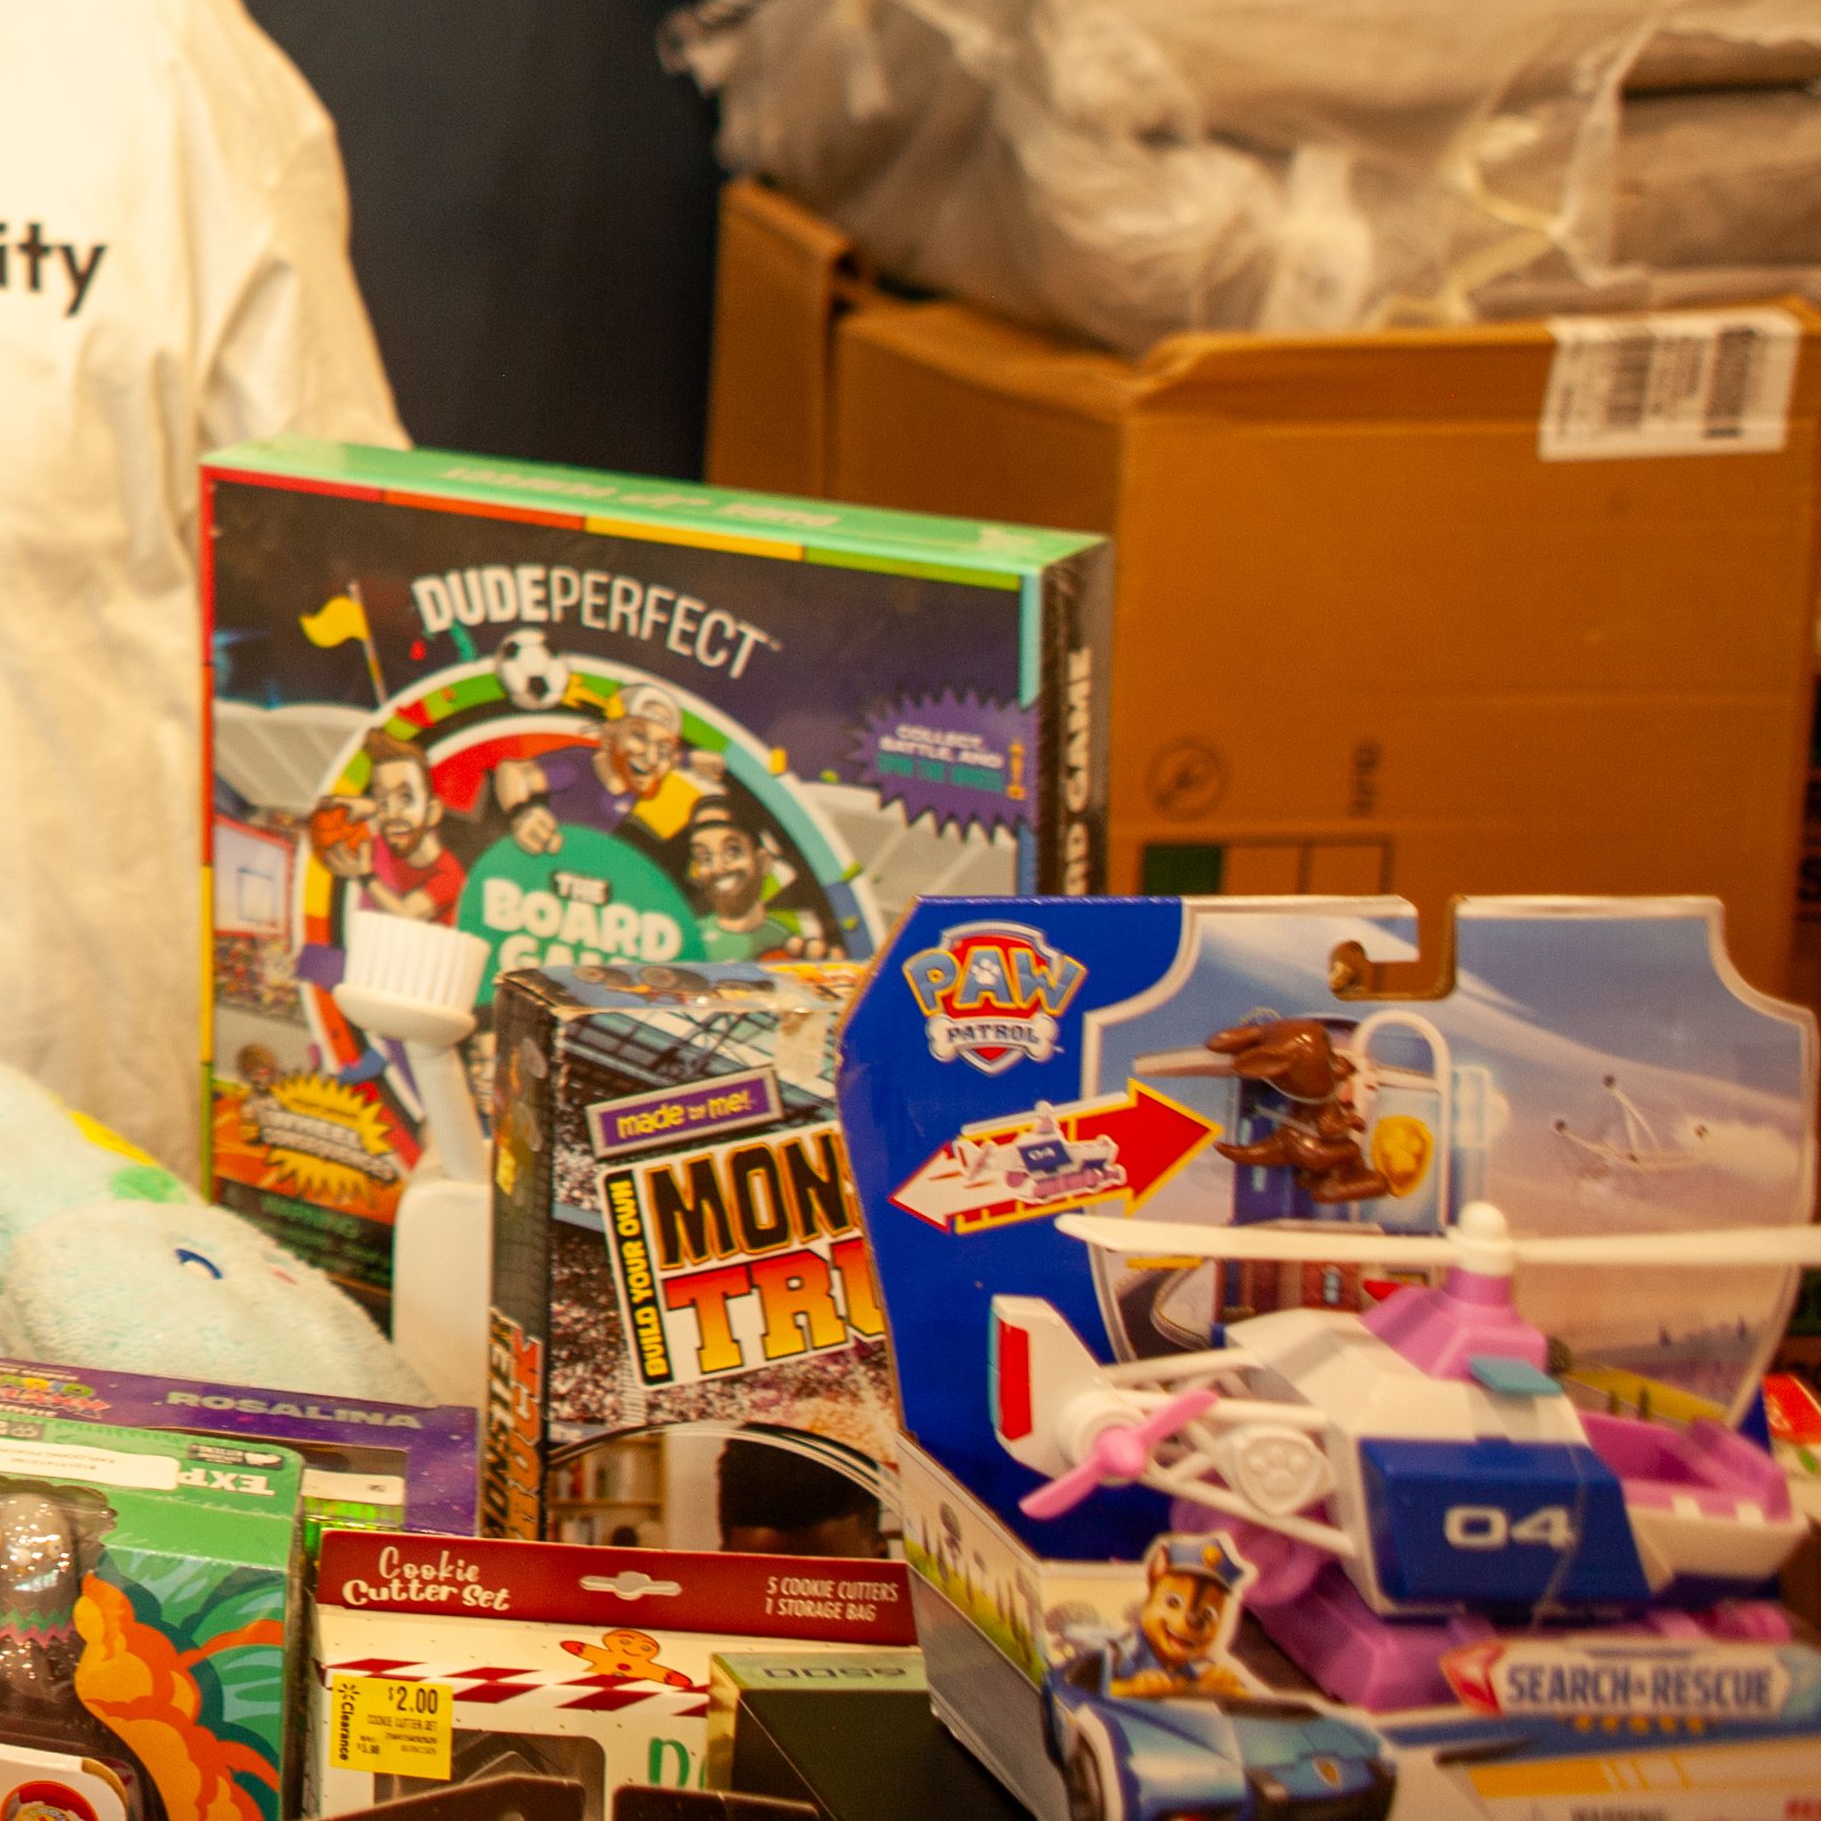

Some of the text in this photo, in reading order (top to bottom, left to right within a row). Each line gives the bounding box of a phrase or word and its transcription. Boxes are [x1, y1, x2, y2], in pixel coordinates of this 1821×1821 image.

[1067, 648, 1093, 815] GAME
[554, 871, 610, 905] THE
[483, 877, 682, 964] BOARD
[902, 945, 1089, 1016] PAW
[946, 1024, 1039, 1044] PATROL
[617, 1104, 685, 1139] made
[708, 1089, 751, 1118] me!
[1026, 1146, 1057, 1163] 04
[645, 1128, 858, 1271] MON
[609, 1180, 669, 1377] BUILD YOUR OWN
[167, 1388, 423, 1431] ROSALINA
[1443, 1505, 1577, 1551] 04
[378, 1545, 480, 1583] Cookie
[341, 1578, 511, 1611] Cutter Set
[767, 1576, 899, 1603] 5 COOKIE CUTTERS
[776, 1598, 844, 1620] STORAGE
[845, 1601, 878, 1623] BAG
[388, 1685, 439, 1715] $2.00
[1507, 1664, 1630, 1707] SEARCH
[1651, 1667, 1772, 1709] RESCUE
[339, 1701, 355, 1762] Clearance
